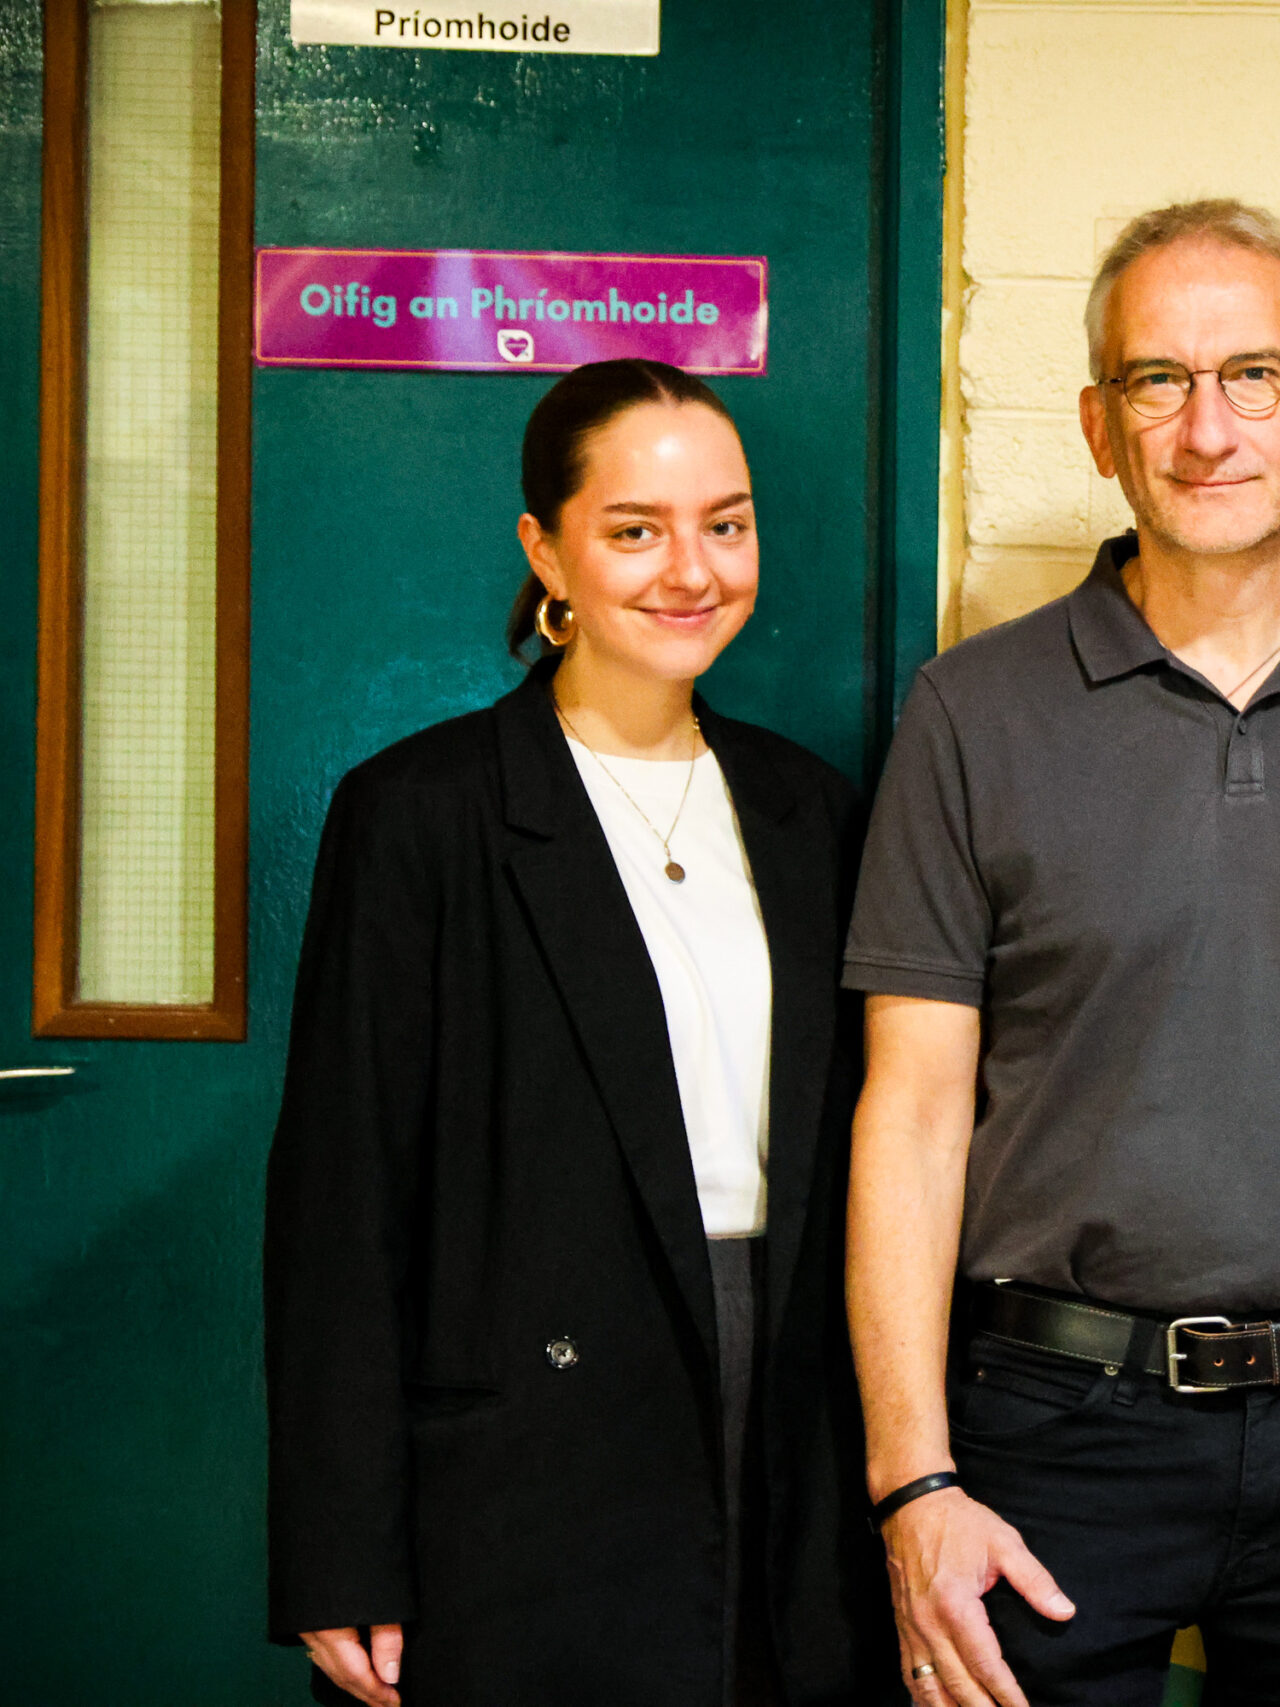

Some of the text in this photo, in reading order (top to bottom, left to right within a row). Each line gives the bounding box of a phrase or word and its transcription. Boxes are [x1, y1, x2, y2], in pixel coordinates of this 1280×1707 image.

[375, 9, 571, 43] Príomhoide
[300, 282, 720, 328] Oifig an Phríomhoide
